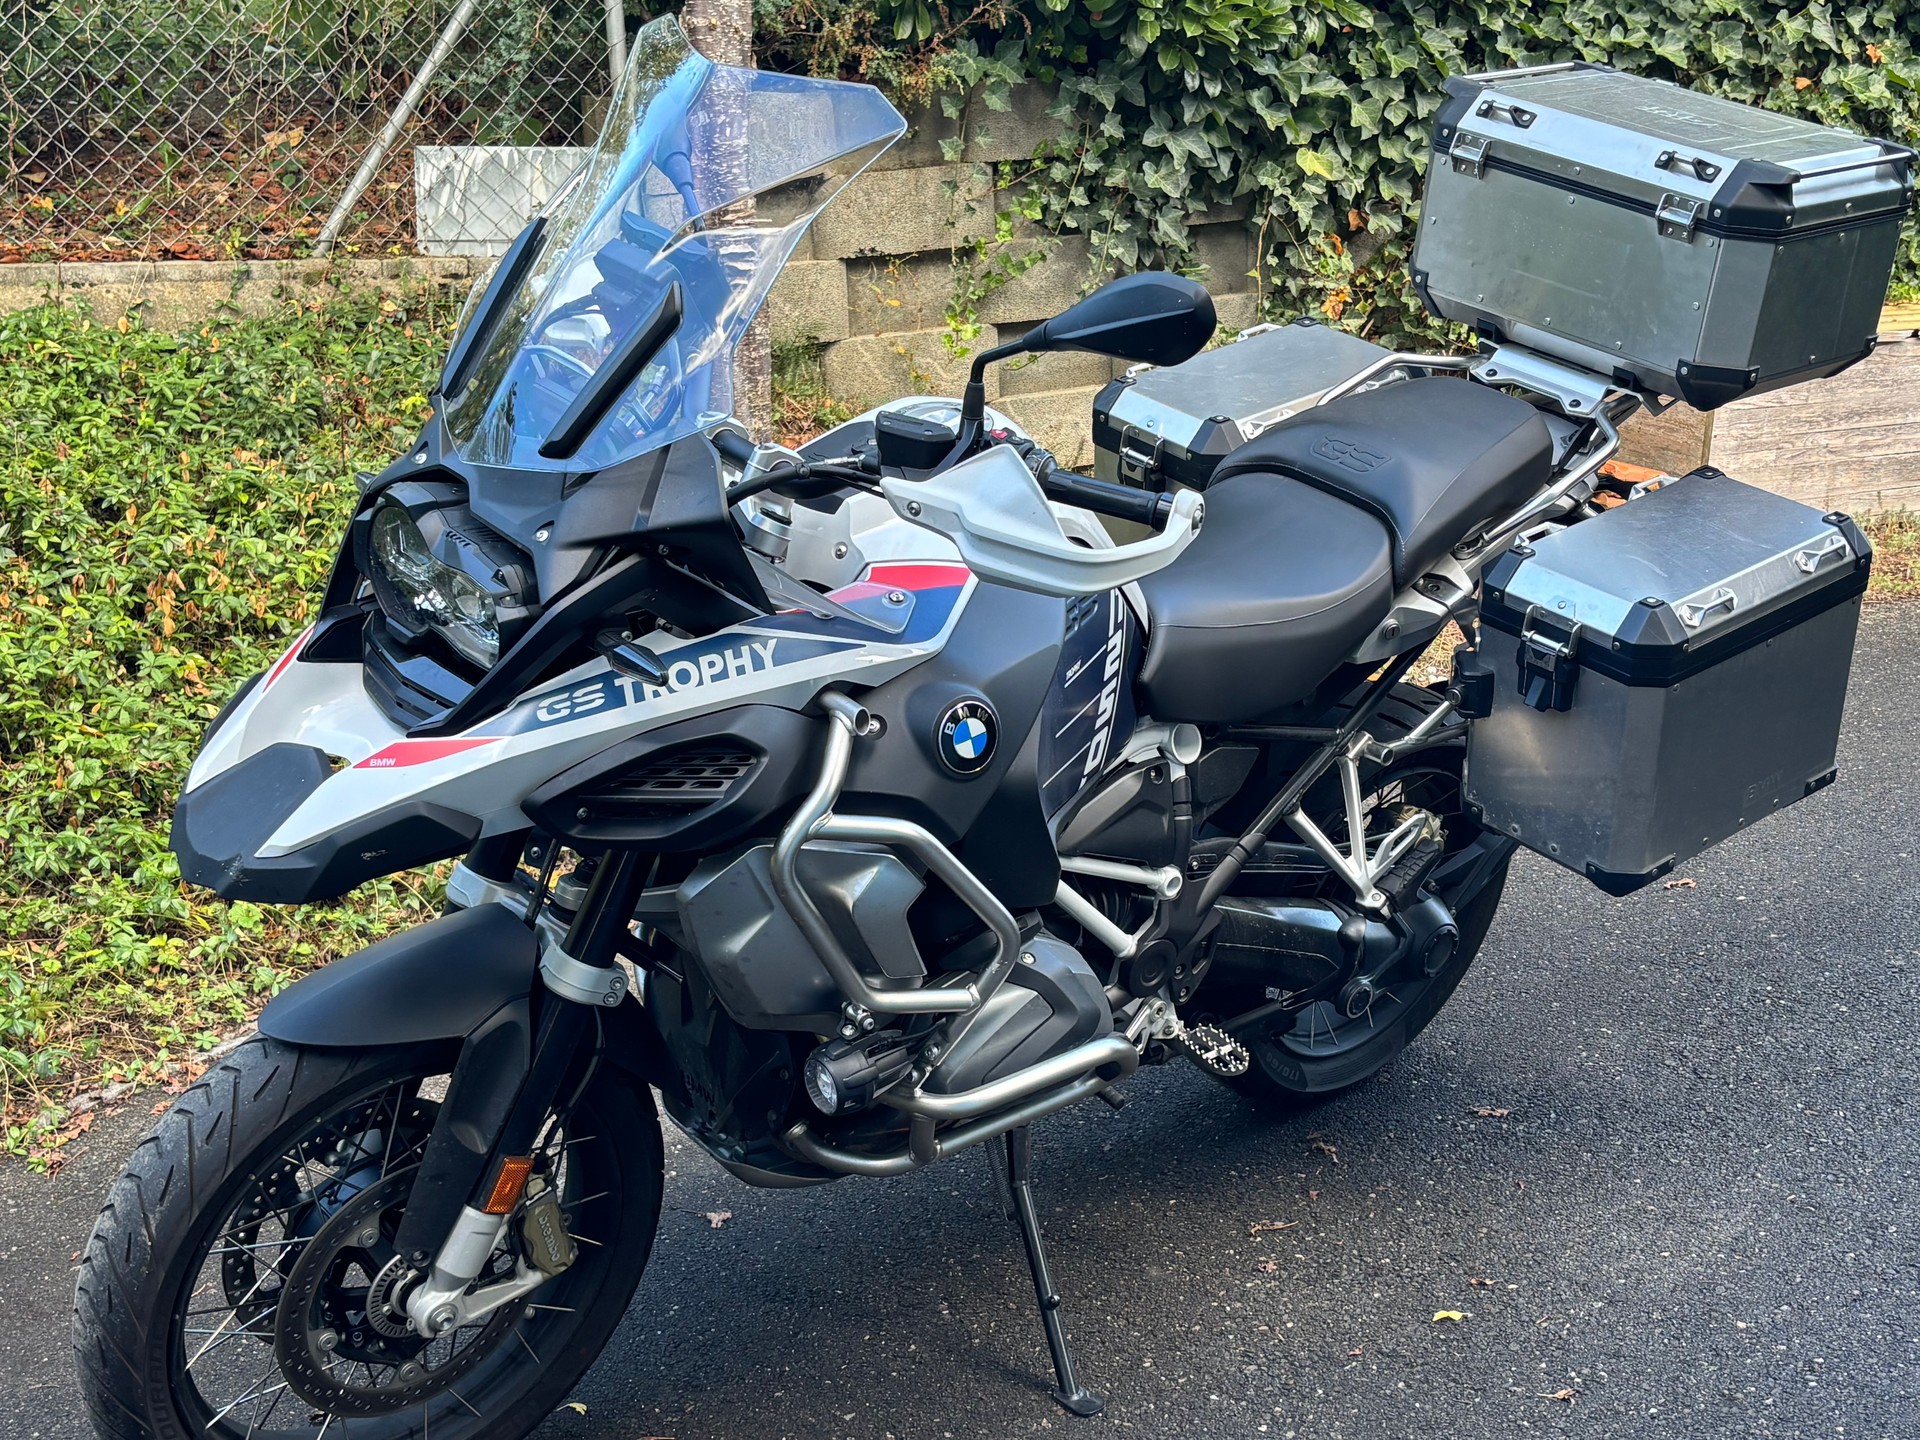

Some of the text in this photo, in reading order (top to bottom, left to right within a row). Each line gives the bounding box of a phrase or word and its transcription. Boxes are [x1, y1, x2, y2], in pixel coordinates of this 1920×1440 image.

[536, 682, 606, 723] GS
[943, 706, 989, 736] BMW
[370, 757, 397, 767] BMW
[1266, 1052, 1299, 1081] 170/60
[538, 1211, 561, 1262] brembo
